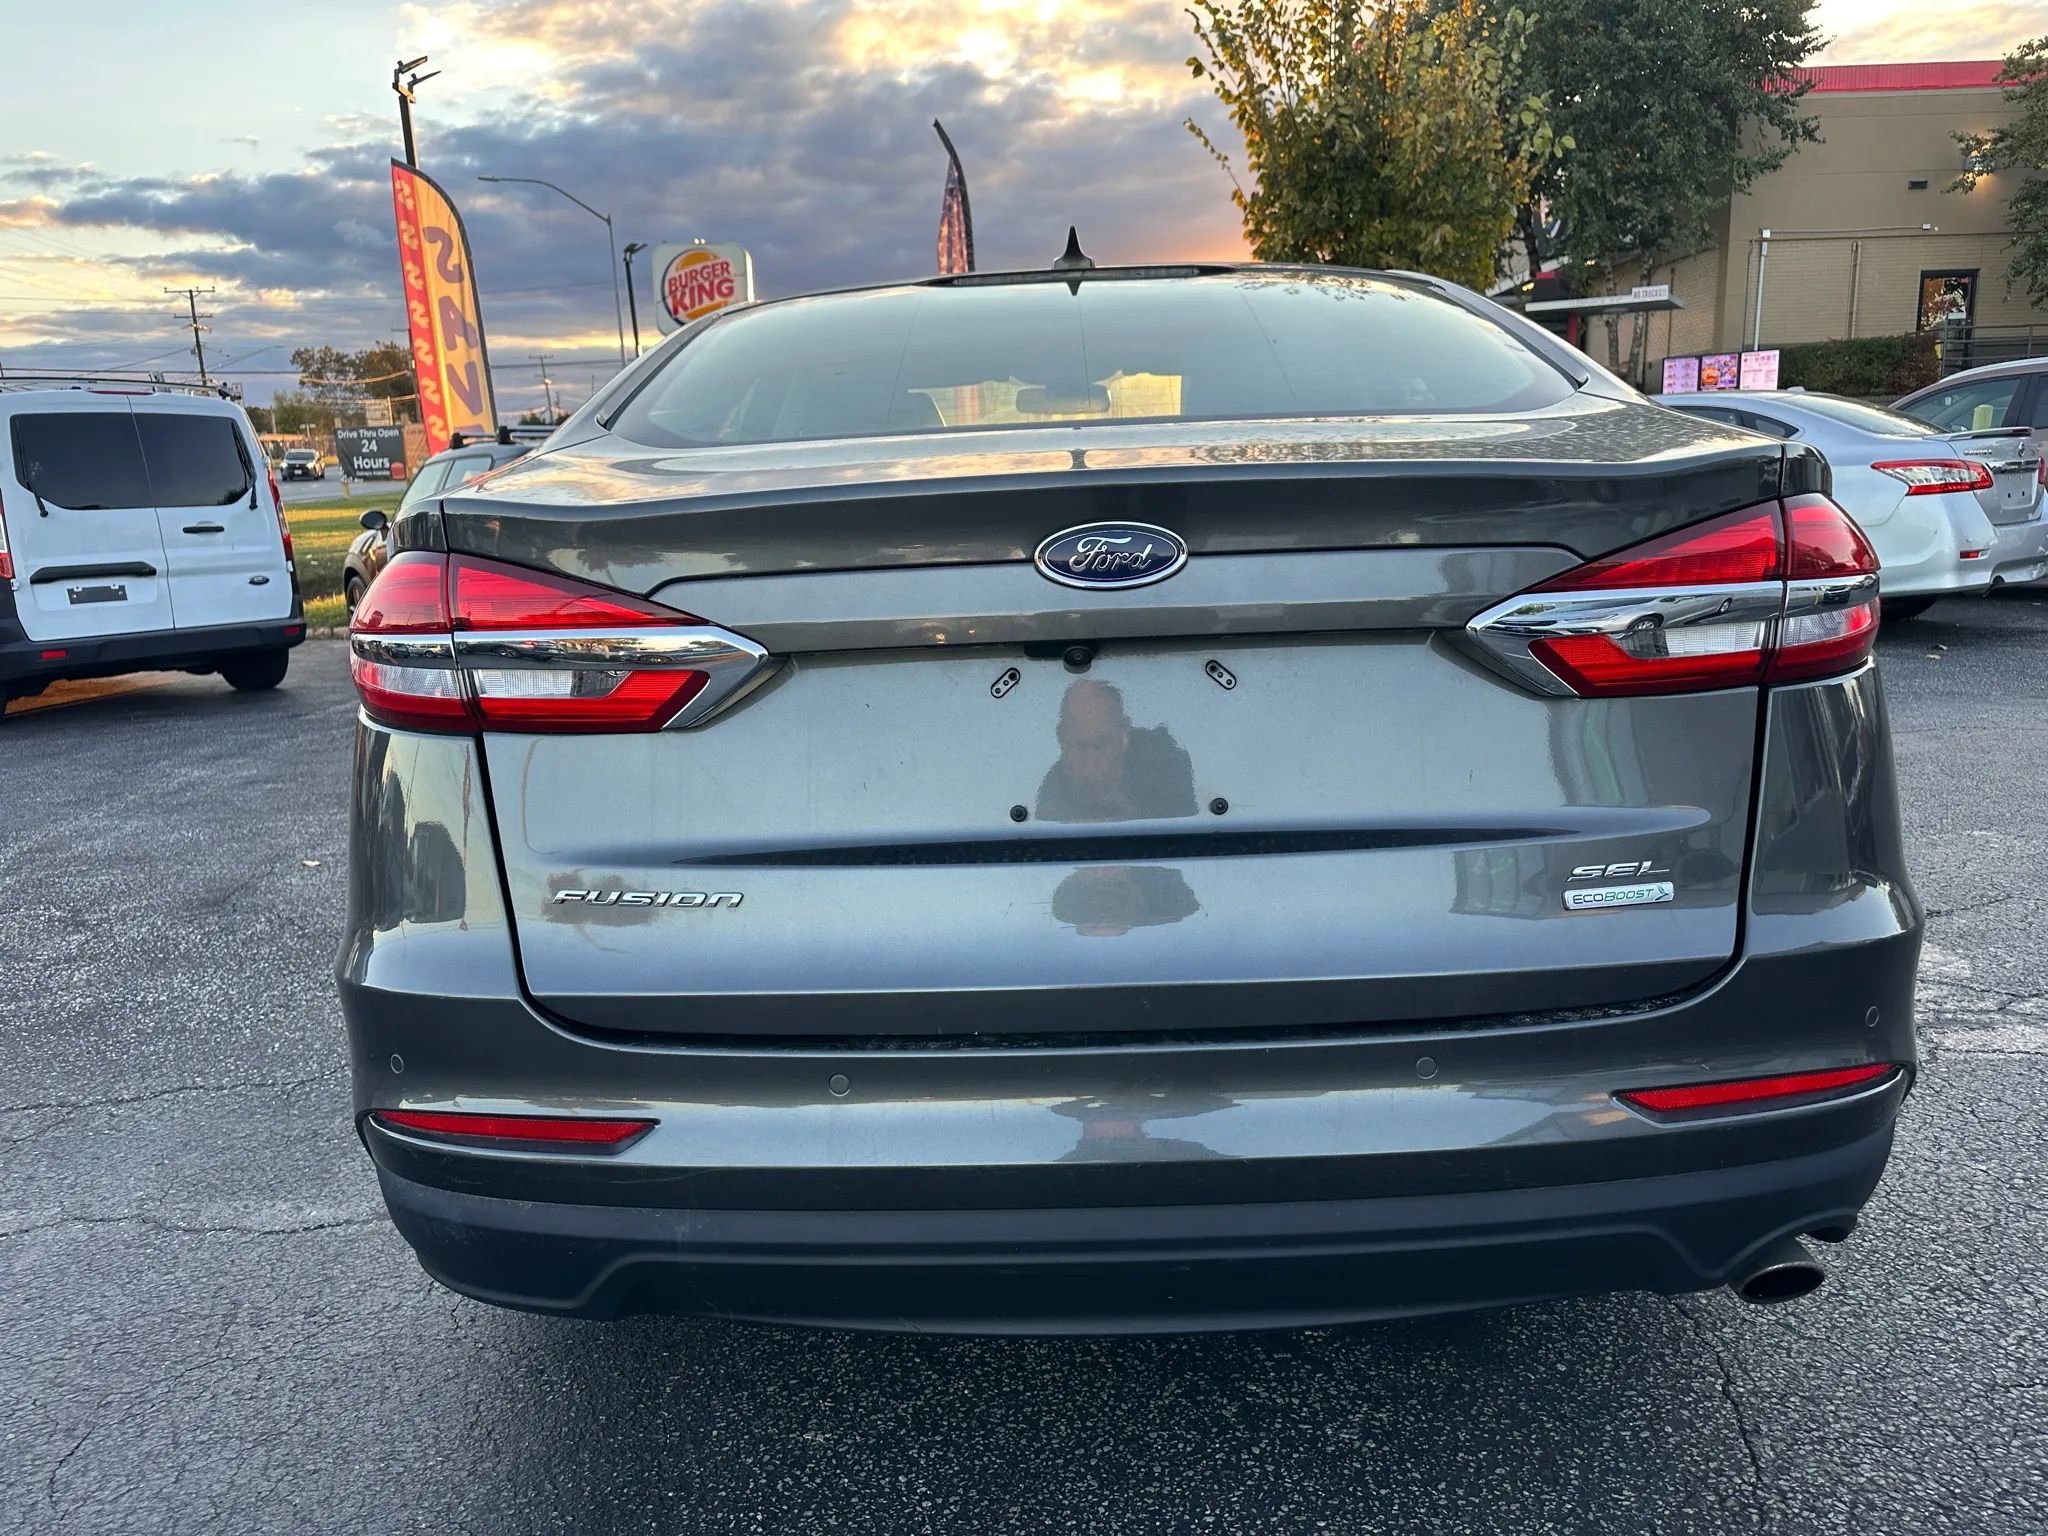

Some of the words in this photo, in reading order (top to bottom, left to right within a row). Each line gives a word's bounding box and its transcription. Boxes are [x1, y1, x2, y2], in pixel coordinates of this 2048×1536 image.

[667, 261, 731, 296] BURGER
[671, 278, 734, 316] KING
[337, 429, 357, 439] Drive
[360, 429, 377, 438] Thru
[378, 428, 400, 438] Open
[361, 439, 378, 453] 24
[353, 456, 390, 469] Hours
[1069, 536, 1153, 572] Ford
[1567, 861, 1670, 882] SEL
[552, 889, 745, 908] FUSION
[1572, 888, 1654, 905] ECOBOOST
